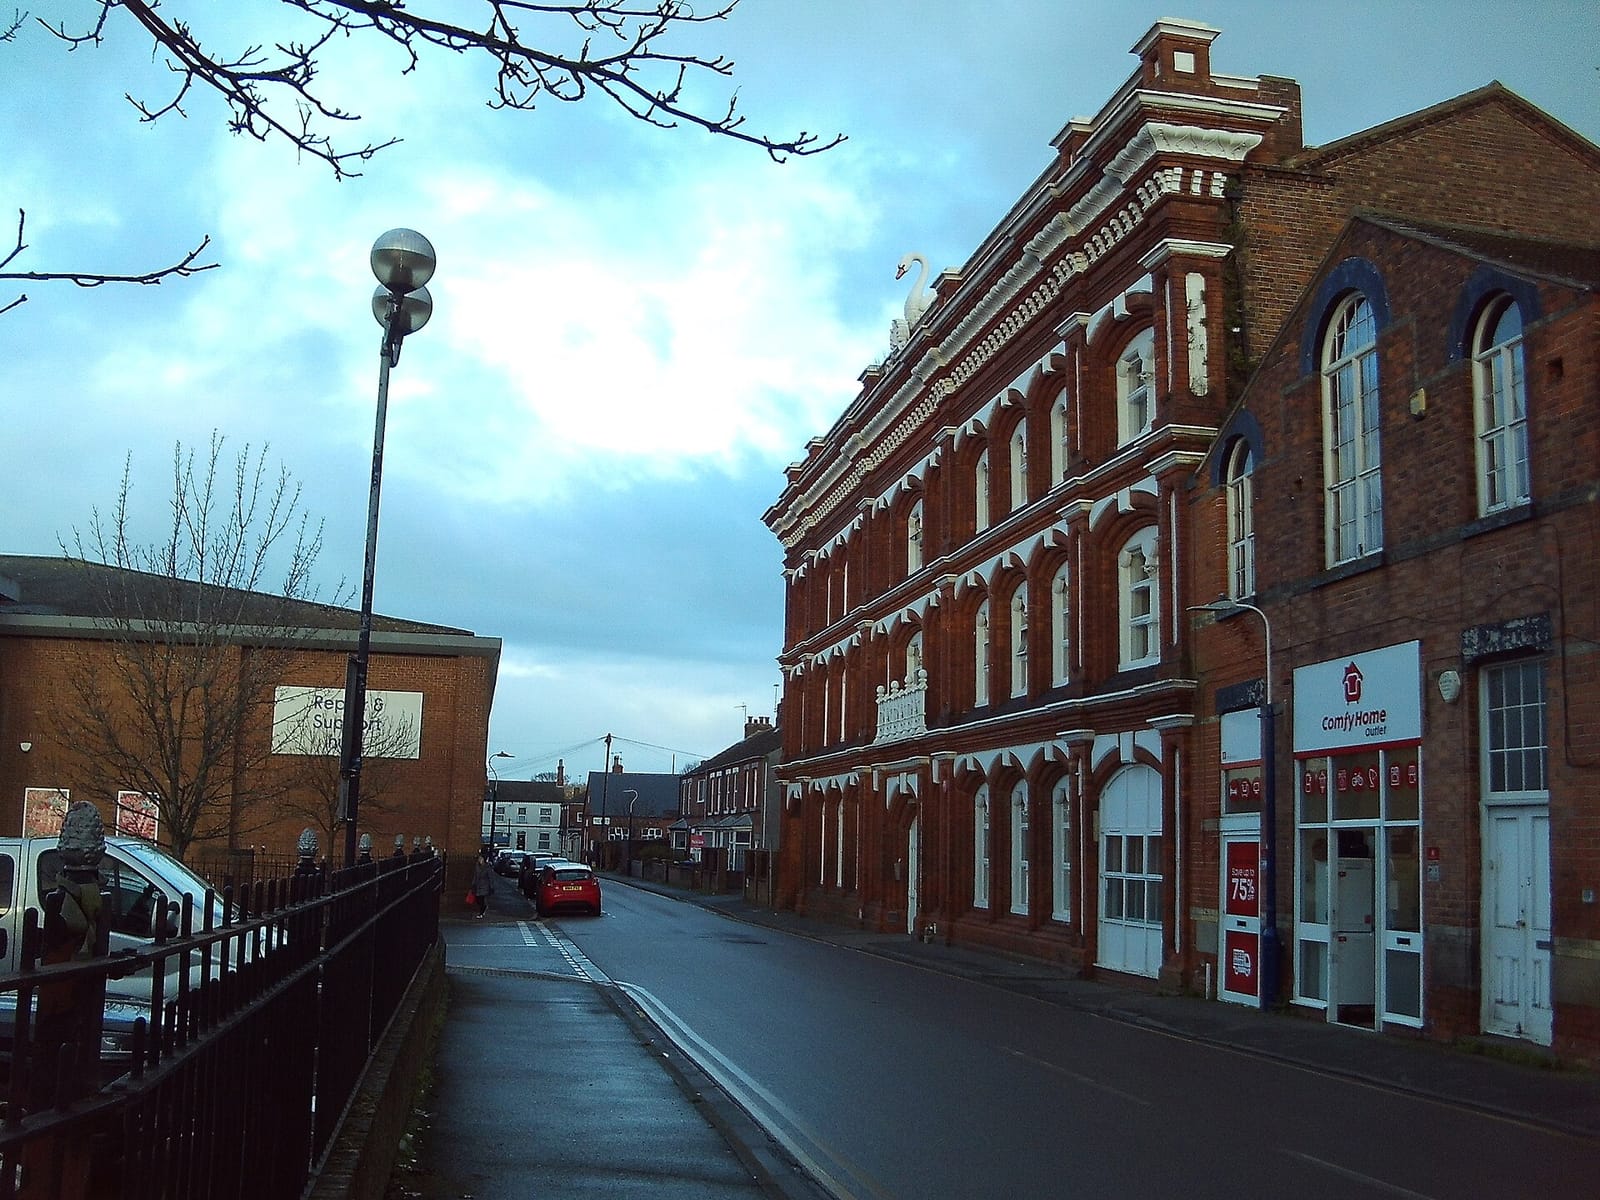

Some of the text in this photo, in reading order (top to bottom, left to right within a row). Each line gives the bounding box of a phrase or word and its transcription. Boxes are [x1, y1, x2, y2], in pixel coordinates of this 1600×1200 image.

[373, 697, 384, 712] &
[312, 714, 382, 733] Suport
[1231, 877, 1255, 901] 75%
